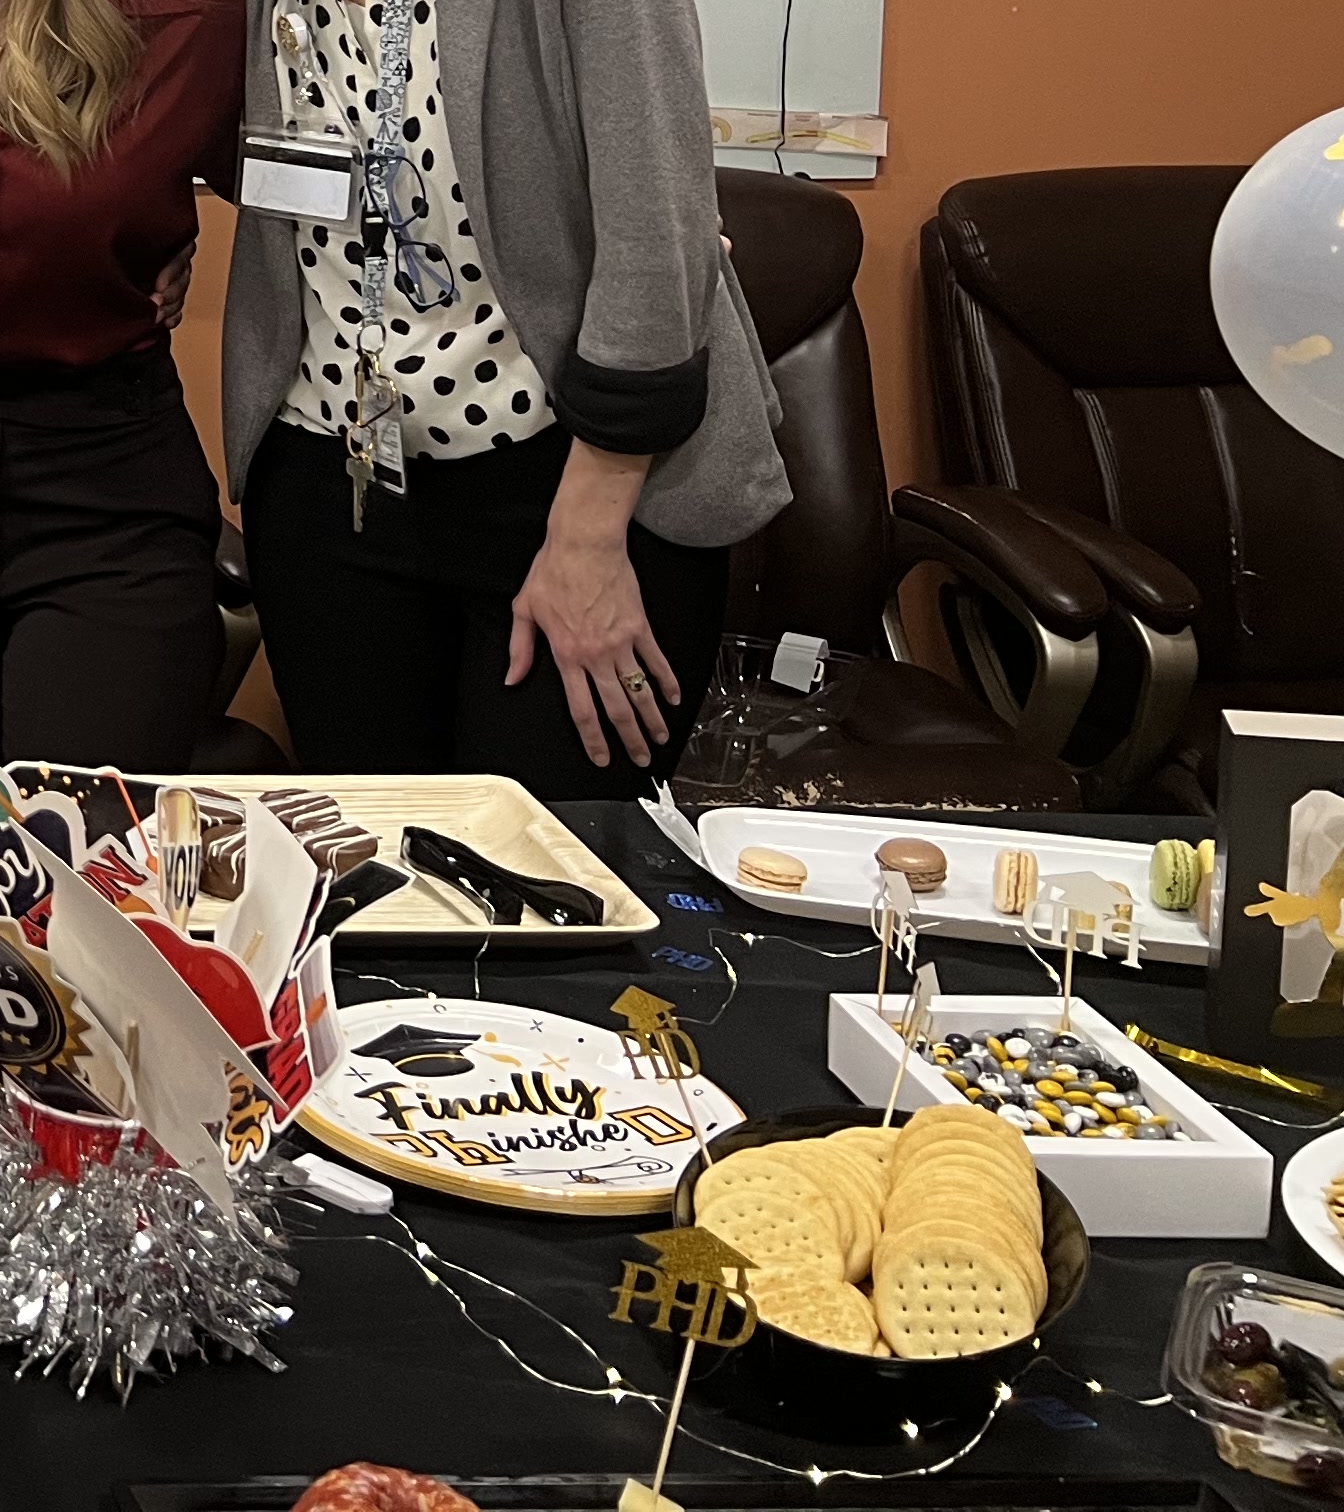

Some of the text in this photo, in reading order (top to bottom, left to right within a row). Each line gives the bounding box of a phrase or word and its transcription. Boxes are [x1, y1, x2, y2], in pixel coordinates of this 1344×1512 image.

[616, 1027, 702, 1080] PHD
[354, 1070, 606, 1131] Finally
[607, 1258, 758, 1348] PHD
